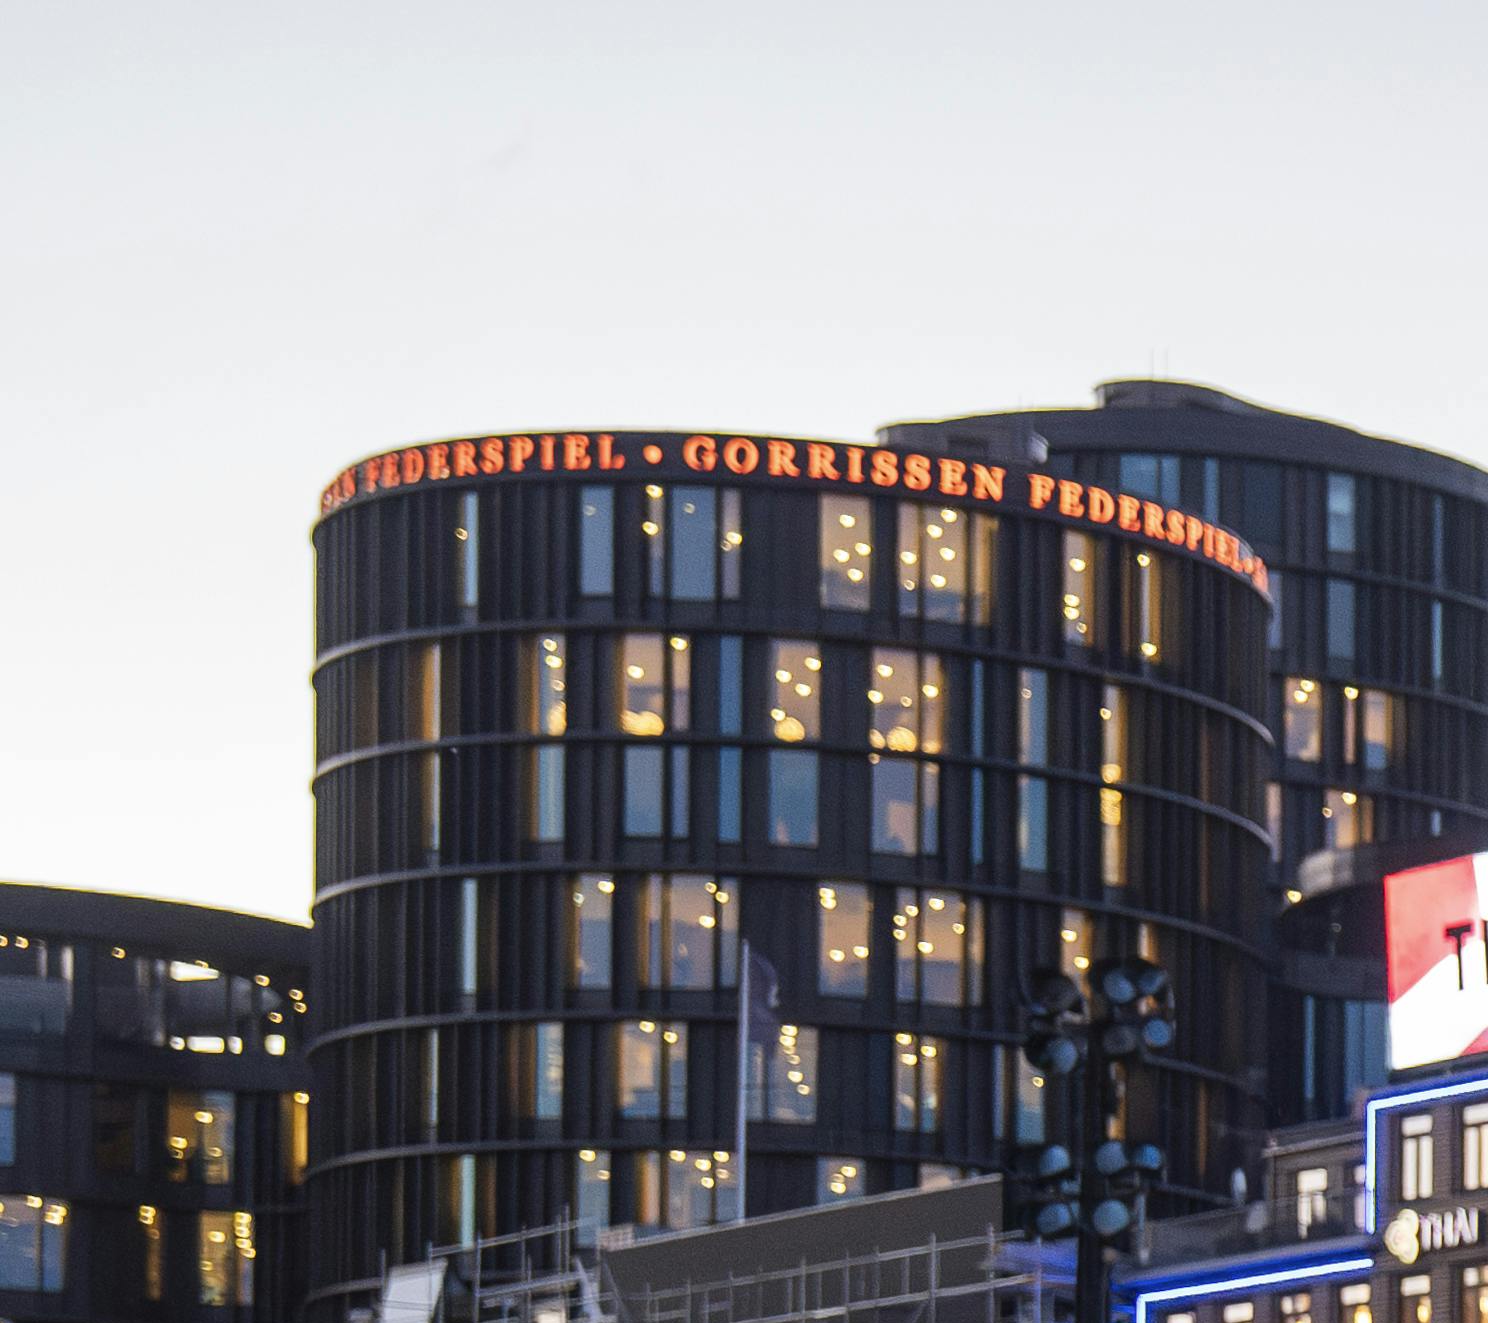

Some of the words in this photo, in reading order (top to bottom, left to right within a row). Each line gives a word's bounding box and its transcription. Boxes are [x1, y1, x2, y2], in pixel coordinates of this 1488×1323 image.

[363, 433, 626, 493] FEDERSPIEL
[682, 435, 1006, 502] GORRISSEN
[1028, 472, 1250, 570] FEDERSPIEL
